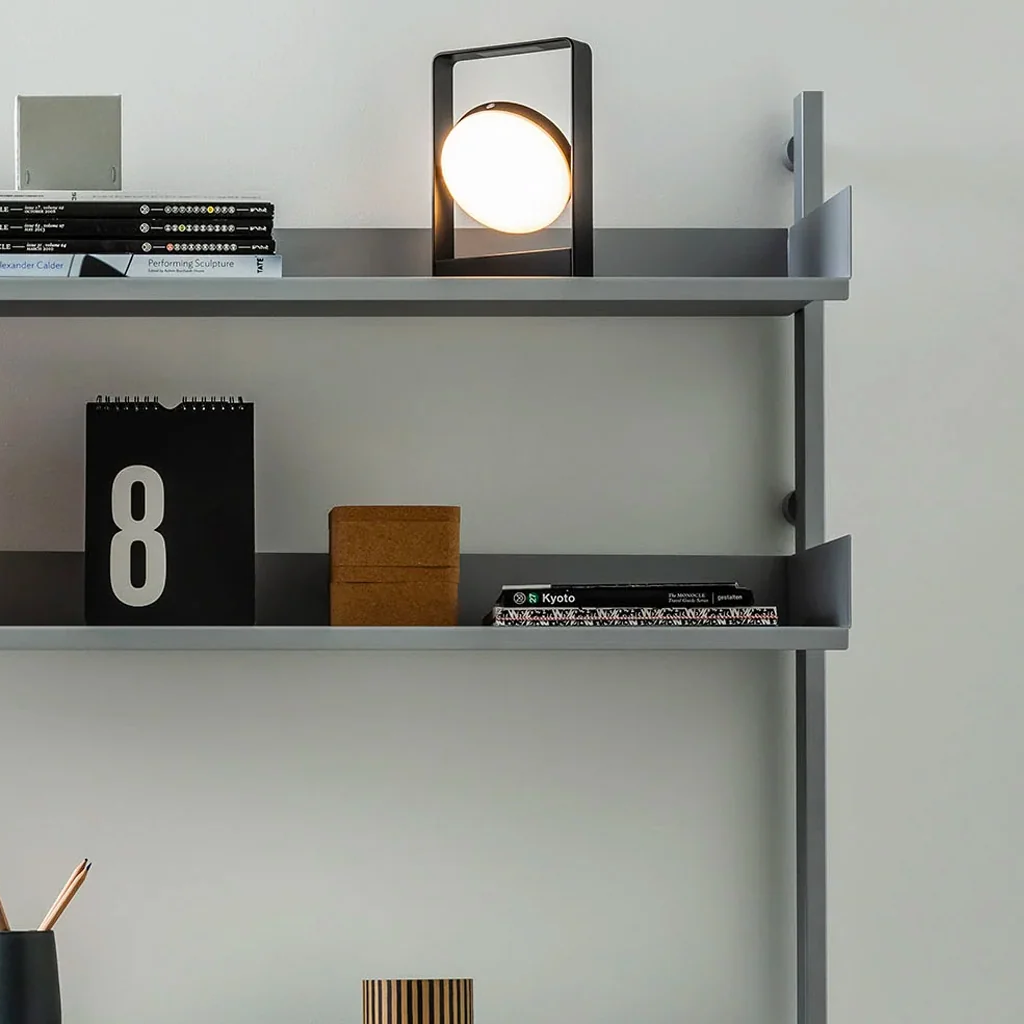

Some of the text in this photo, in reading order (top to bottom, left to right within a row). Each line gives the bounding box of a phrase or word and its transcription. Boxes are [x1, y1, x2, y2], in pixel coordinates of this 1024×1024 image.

[36, 260, 63, 270] Calder
[148, 259, 235, 269] Performing Sculpture
[256, 257, 264, 273] TATE
[110, 464, 167, 607] 8
[528, 592, 576, 604] 27 Kyoto
